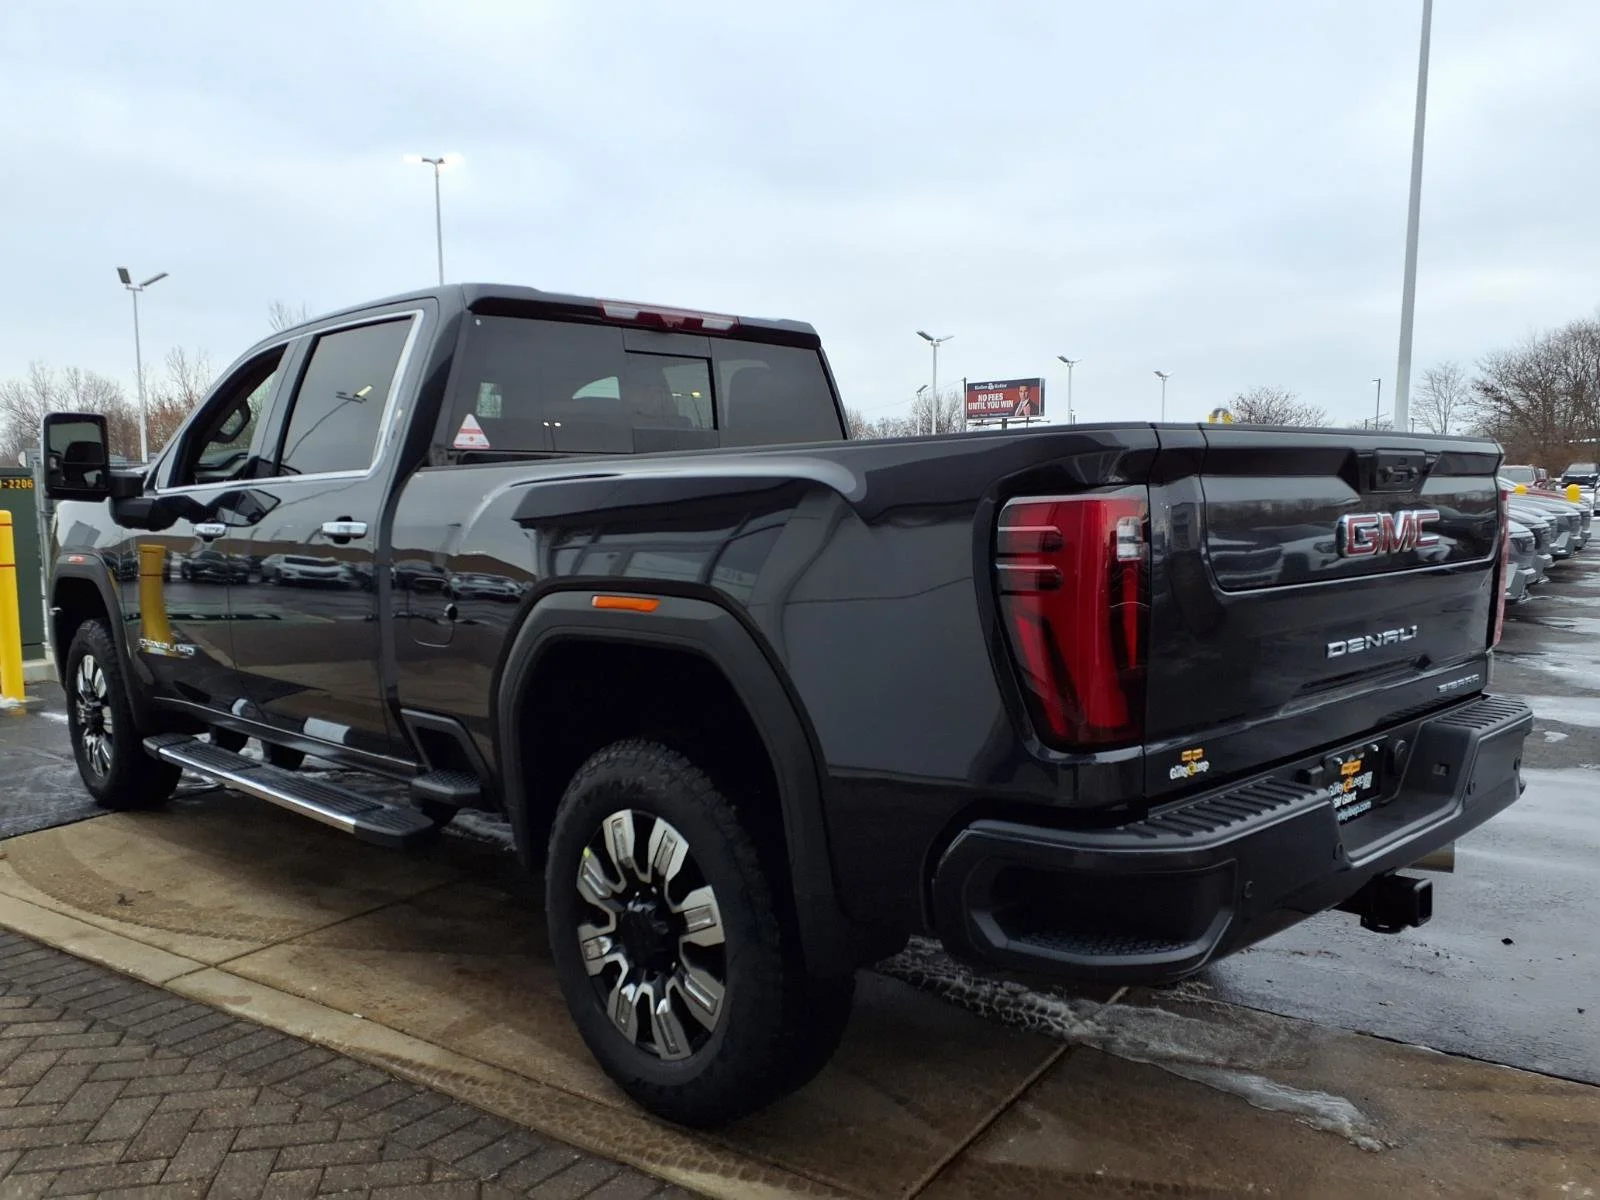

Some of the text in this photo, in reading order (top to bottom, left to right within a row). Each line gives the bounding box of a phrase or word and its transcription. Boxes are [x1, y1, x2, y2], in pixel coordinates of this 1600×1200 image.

[978, 393, 1004, 402] NO FEES
[968, 400, 1014, 410] UNTIL YOU WIN
[0, 479, 33, 489] -2206
[1336, 509, 1440, 558] GMC
[1327, 625, 1418, 659] DENALI
